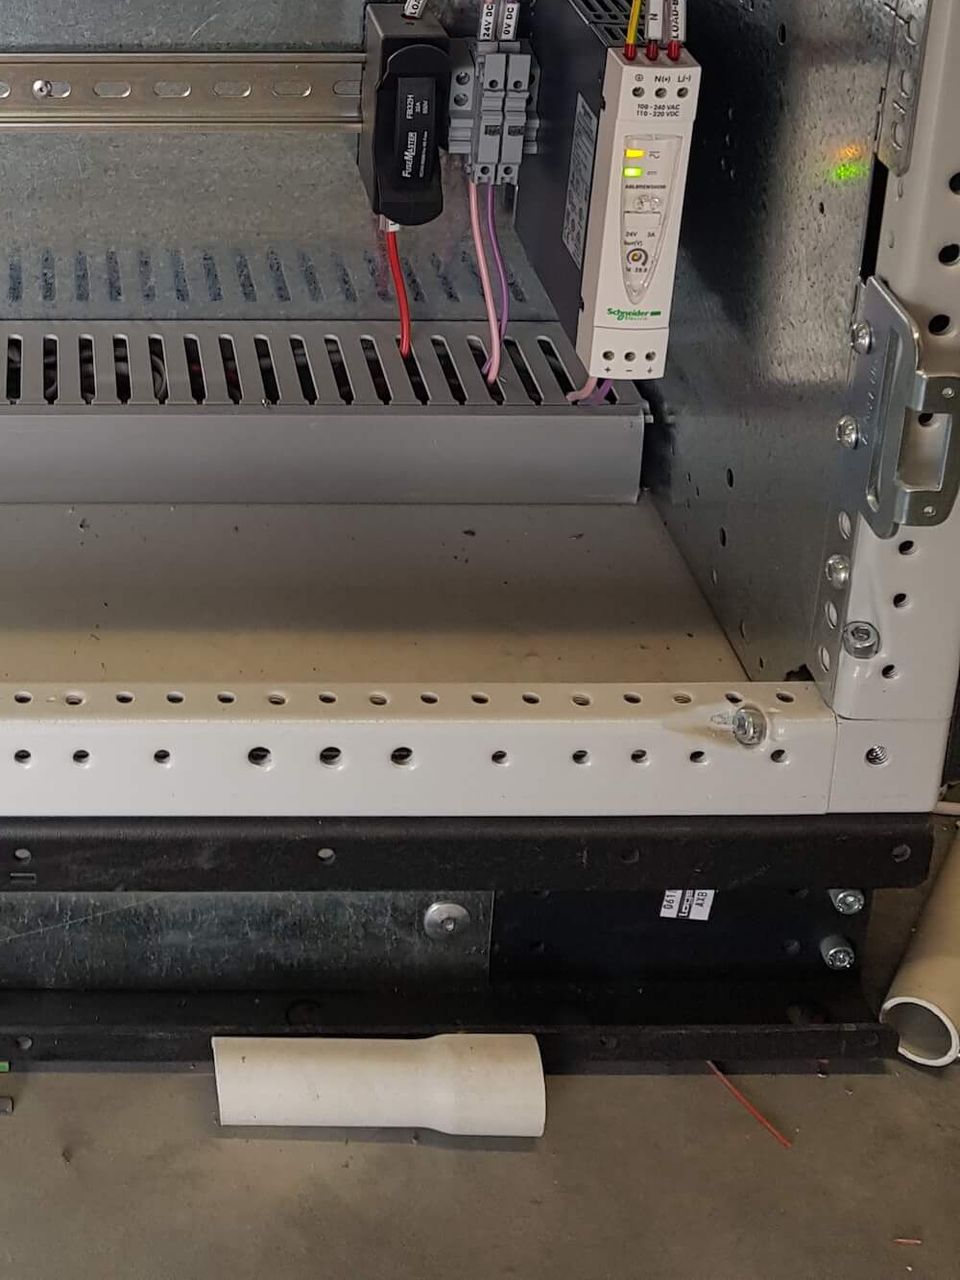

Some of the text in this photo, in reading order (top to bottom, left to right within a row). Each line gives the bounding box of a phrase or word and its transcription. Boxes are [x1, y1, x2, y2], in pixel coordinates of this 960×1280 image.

[482, 4, 494, 38] 24V DC
[503, 7, 514, 35] 0V DC
[649, 13, 658, 21] N
[671, 0, 680, 40] LOAD-B
[607, 308, 649, 320] Schneider
